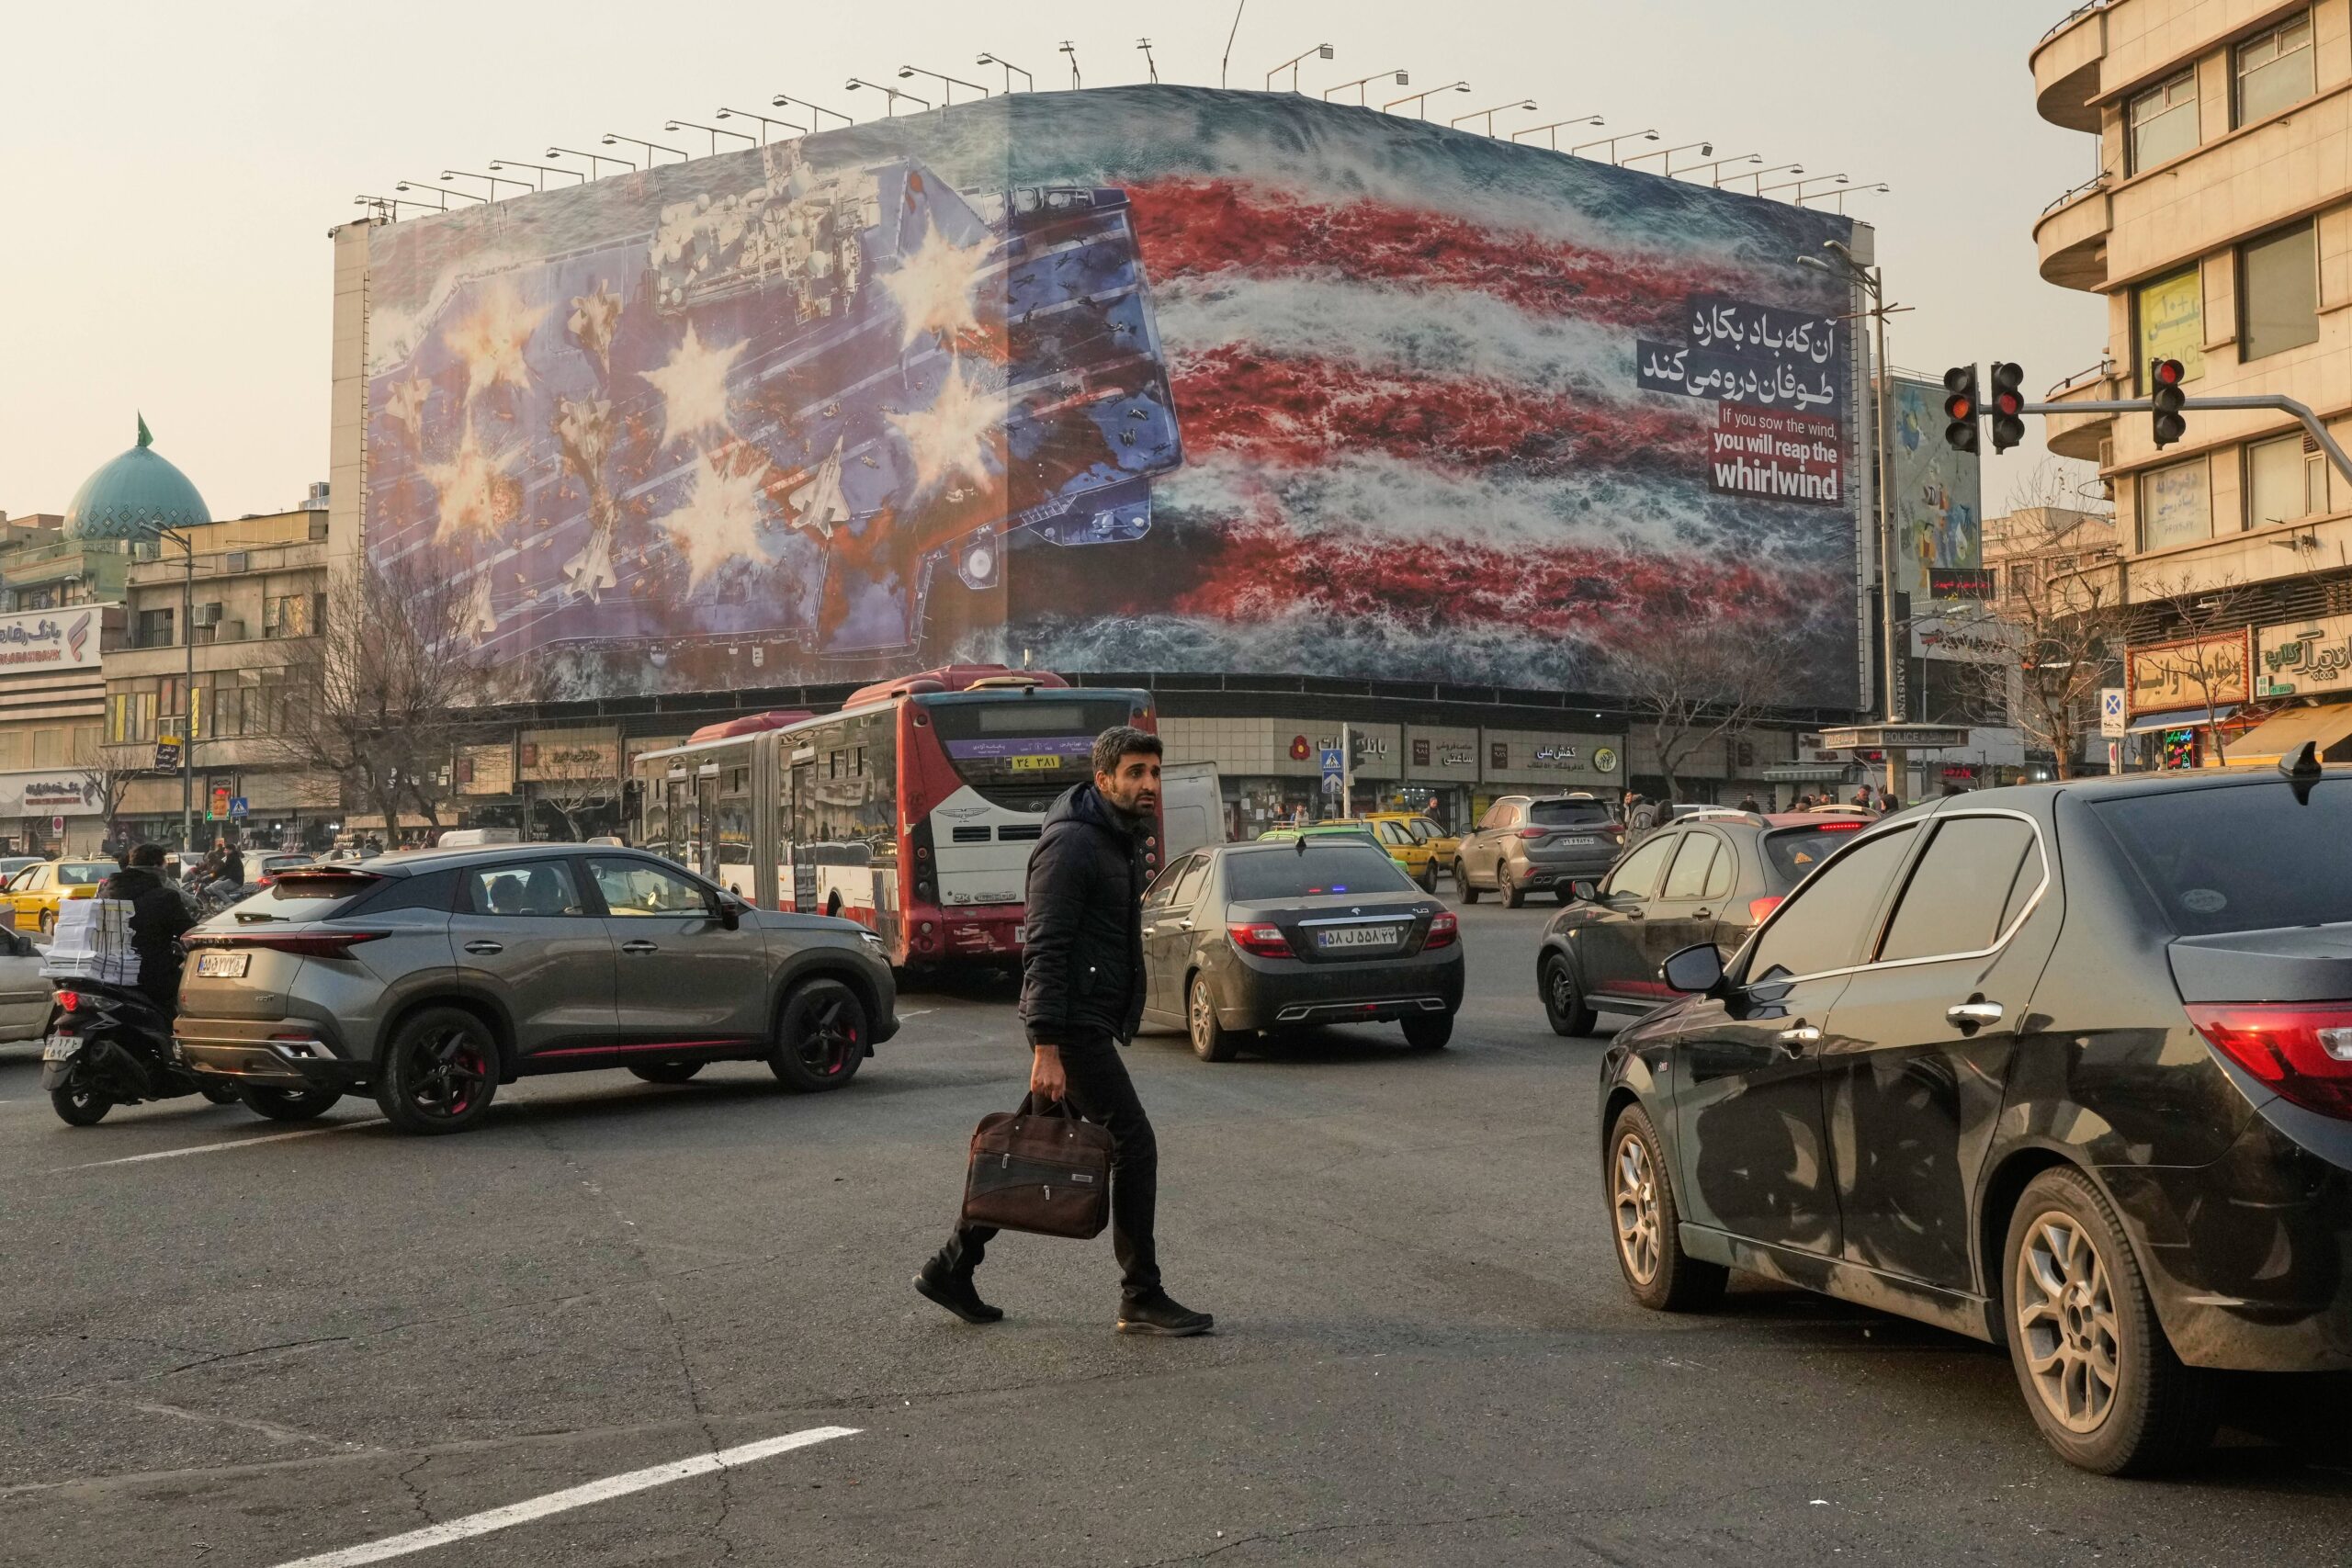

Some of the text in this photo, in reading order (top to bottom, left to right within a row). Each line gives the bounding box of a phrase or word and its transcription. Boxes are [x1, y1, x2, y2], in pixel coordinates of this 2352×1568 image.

[1692, 303, 1744, 352] بکارد
[1749, 312, 1782, 357] باد
[1721, 368, 1758, 401] درو
[1758, 363, 1834, 411] طوفان
[1723, 408, 1837, 441] If you sow the wind,
[1713, 432, 1837, 465] you will reap the
[1714, 456, 1837, 501] whirlwind
[28, 619, 62, 645] بانک
[1896, 659, 1905, 720] SAMSUNG
[1536, 744, 1576, 760] کفش ملی
[1885, 732, 1918, 742] POLICE
[1443, 752, 1474, 765] ساعتی
[1328, 931, 1342, 944] ۵۸
[1357, 930, 1379, 943] ۵۵۸
